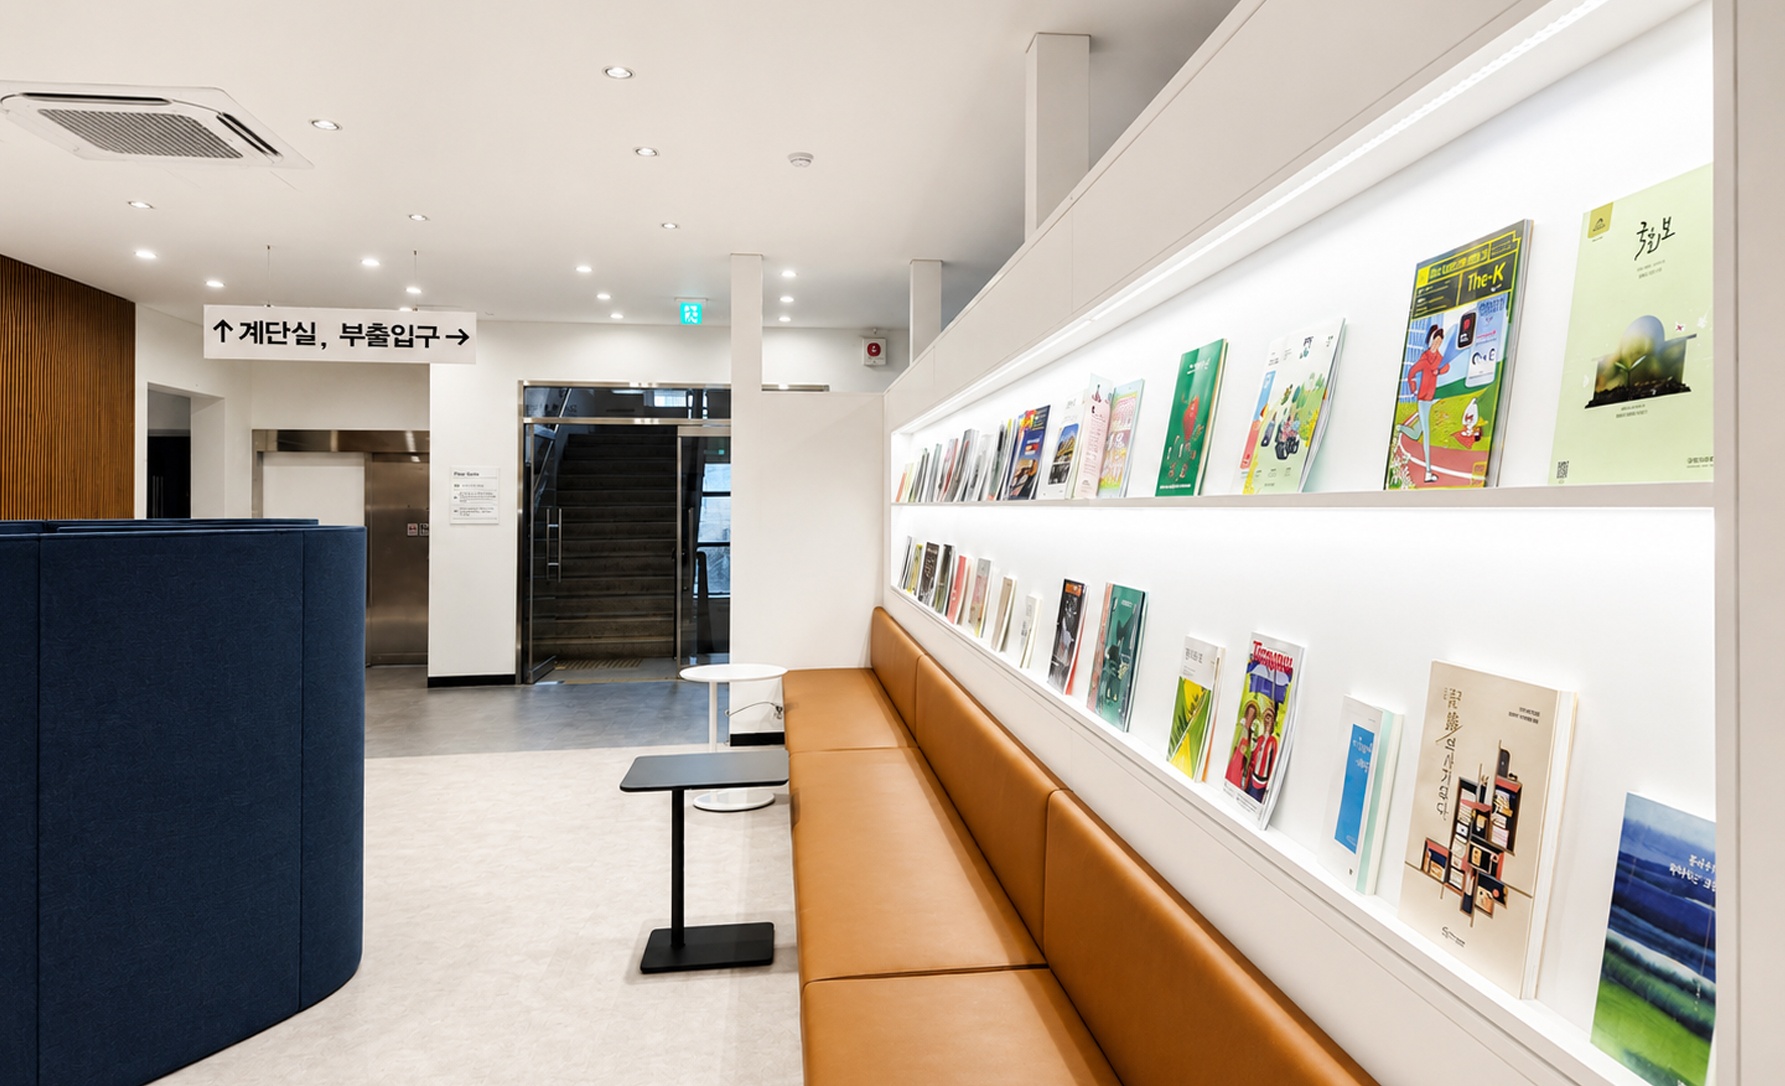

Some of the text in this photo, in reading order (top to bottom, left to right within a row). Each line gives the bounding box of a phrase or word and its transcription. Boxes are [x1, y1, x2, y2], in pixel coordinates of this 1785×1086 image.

[1467, 261, 1506, 292] The-K
[239, 320, 441, 350] 계단실, 부출입구
